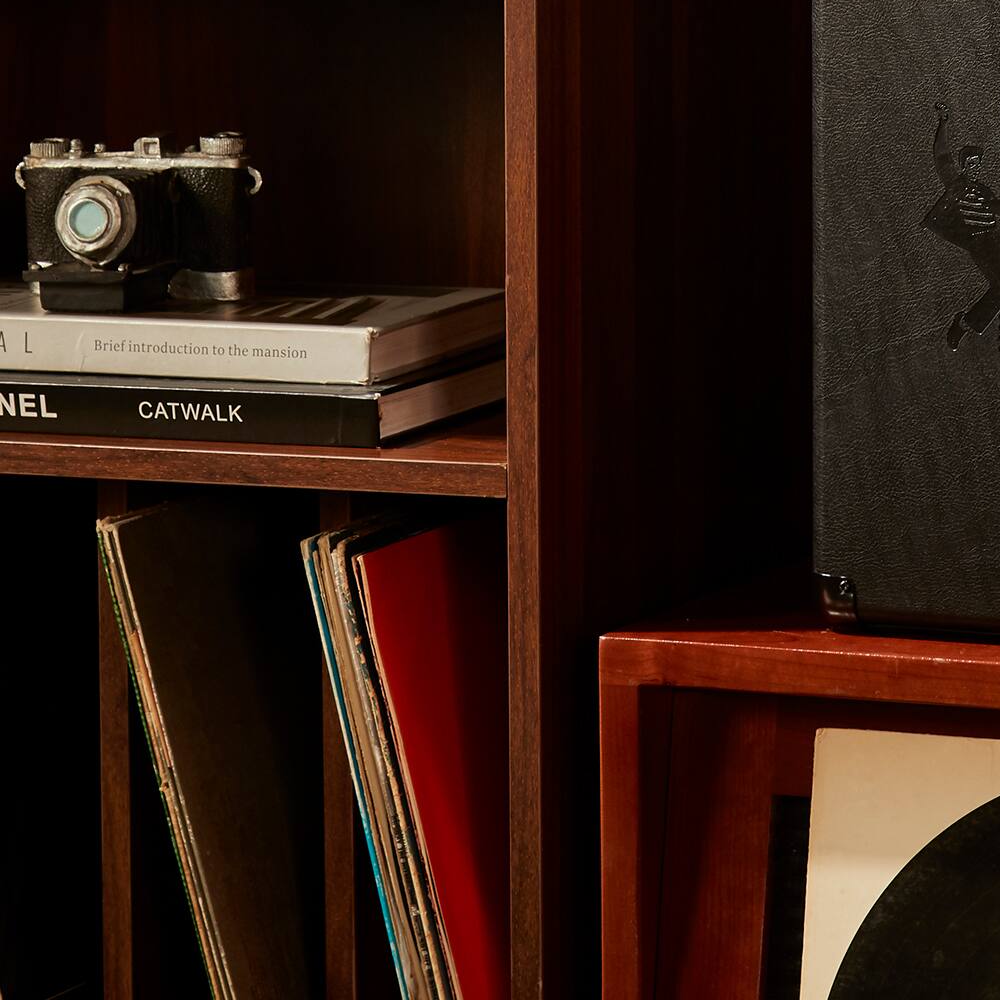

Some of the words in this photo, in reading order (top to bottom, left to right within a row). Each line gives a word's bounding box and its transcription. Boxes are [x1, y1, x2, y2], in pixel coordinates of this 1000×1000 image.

[94, 339, 126, 352] Brief
[128, 340, 209, 356] introduction
[212, 344, 225, 356] to
[228, 344, 249, 357] the
[252, 345, 308, 359] mansion
[138, 400, 243, 423] CATWALK
